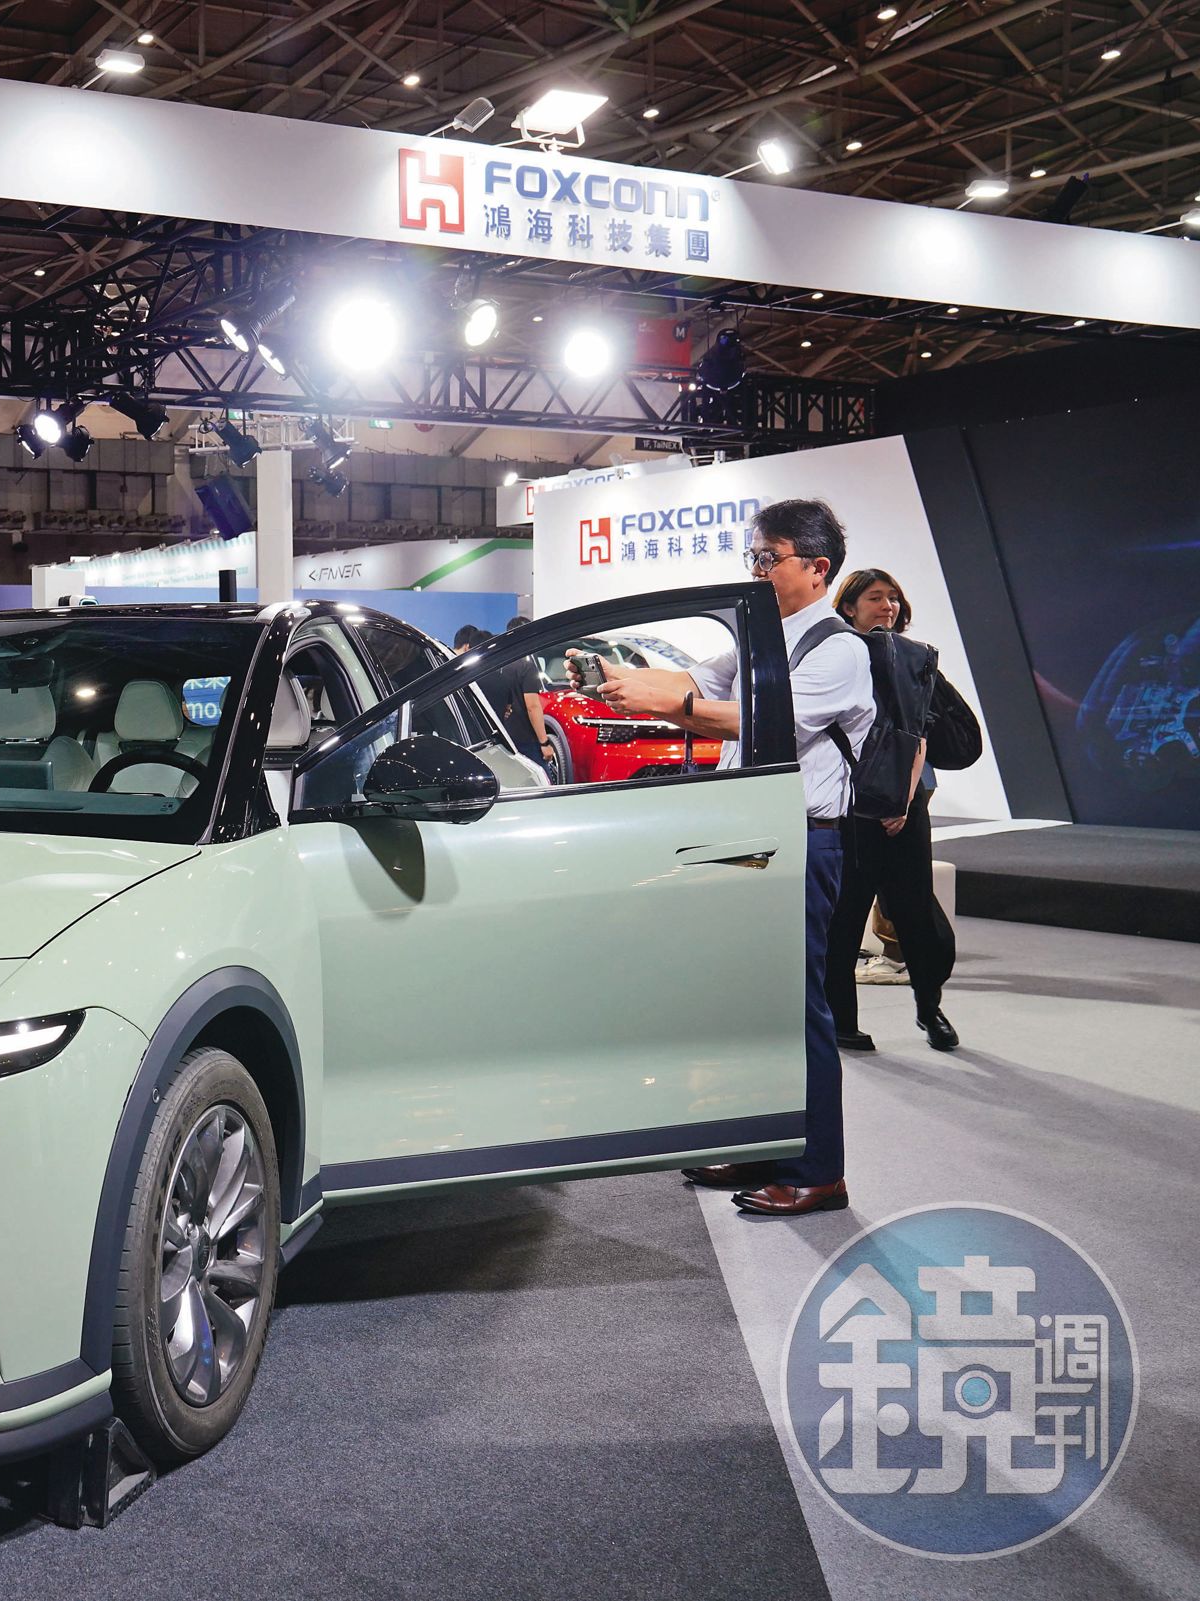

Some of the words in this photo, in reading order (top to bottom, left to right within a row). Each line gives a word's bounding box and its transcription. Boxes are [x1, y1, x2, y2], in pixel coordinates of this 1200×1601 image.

[484, 160, 710, 222] FOXCONN
[483, 203, 710, 263] 鴻海科技集團
[621, 497, 761, 536] FOXCONN
